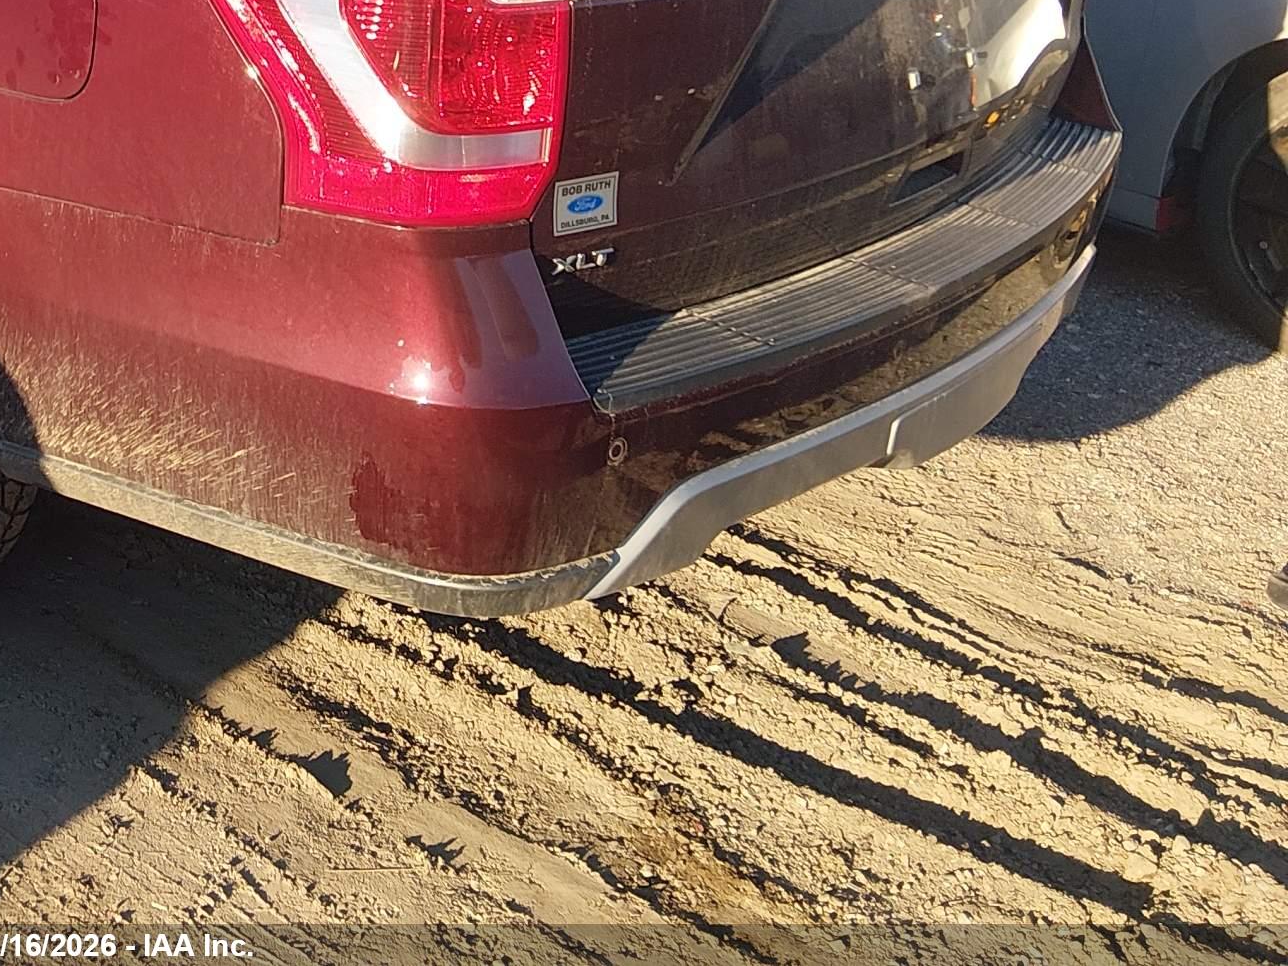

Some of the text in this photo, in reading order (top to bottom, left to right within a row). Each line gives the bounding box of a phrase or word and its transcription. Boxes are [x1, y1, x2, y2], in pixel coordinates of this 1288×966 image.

[562, 179, 611, 197] BOB RUTH
[552, 248, 615, 275] XLT
